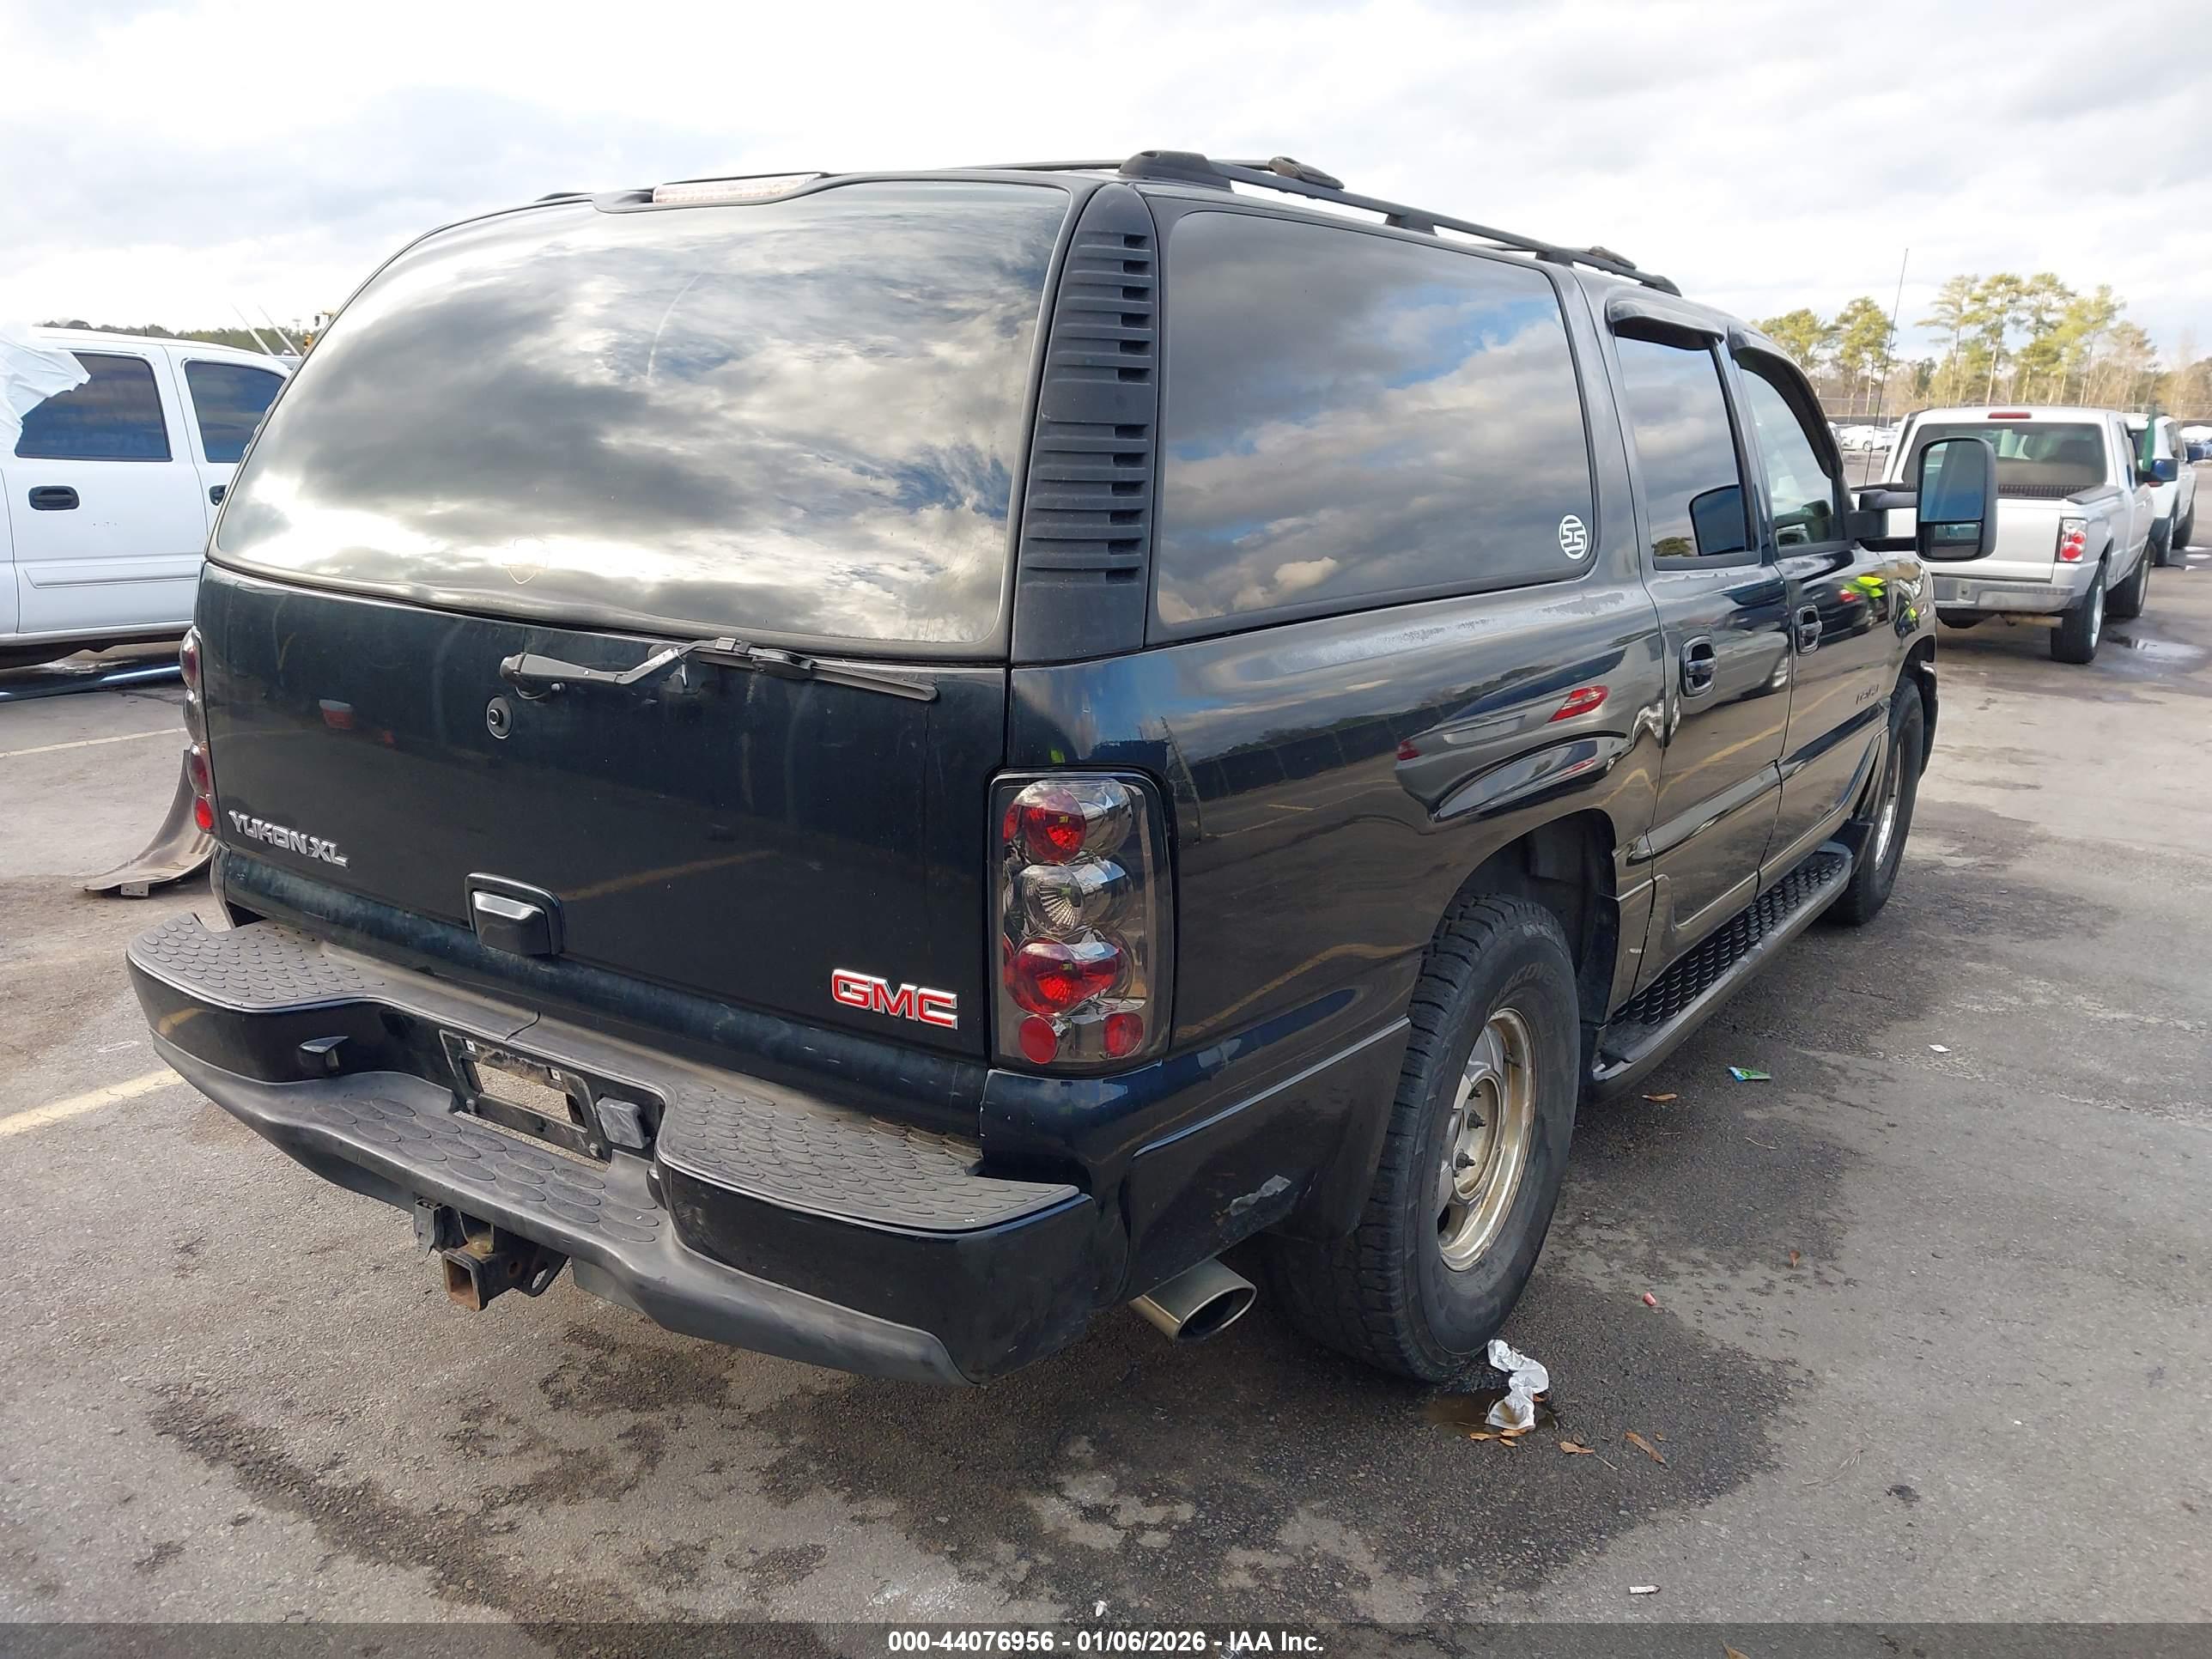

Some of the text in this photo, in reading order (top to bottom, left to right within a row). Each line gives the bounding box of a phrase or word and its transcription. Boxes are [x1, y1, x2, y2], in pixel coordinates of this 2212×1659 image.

[228, 810, 350, 868] YUKON XL
[830, 968, 959, 1030] GMC
